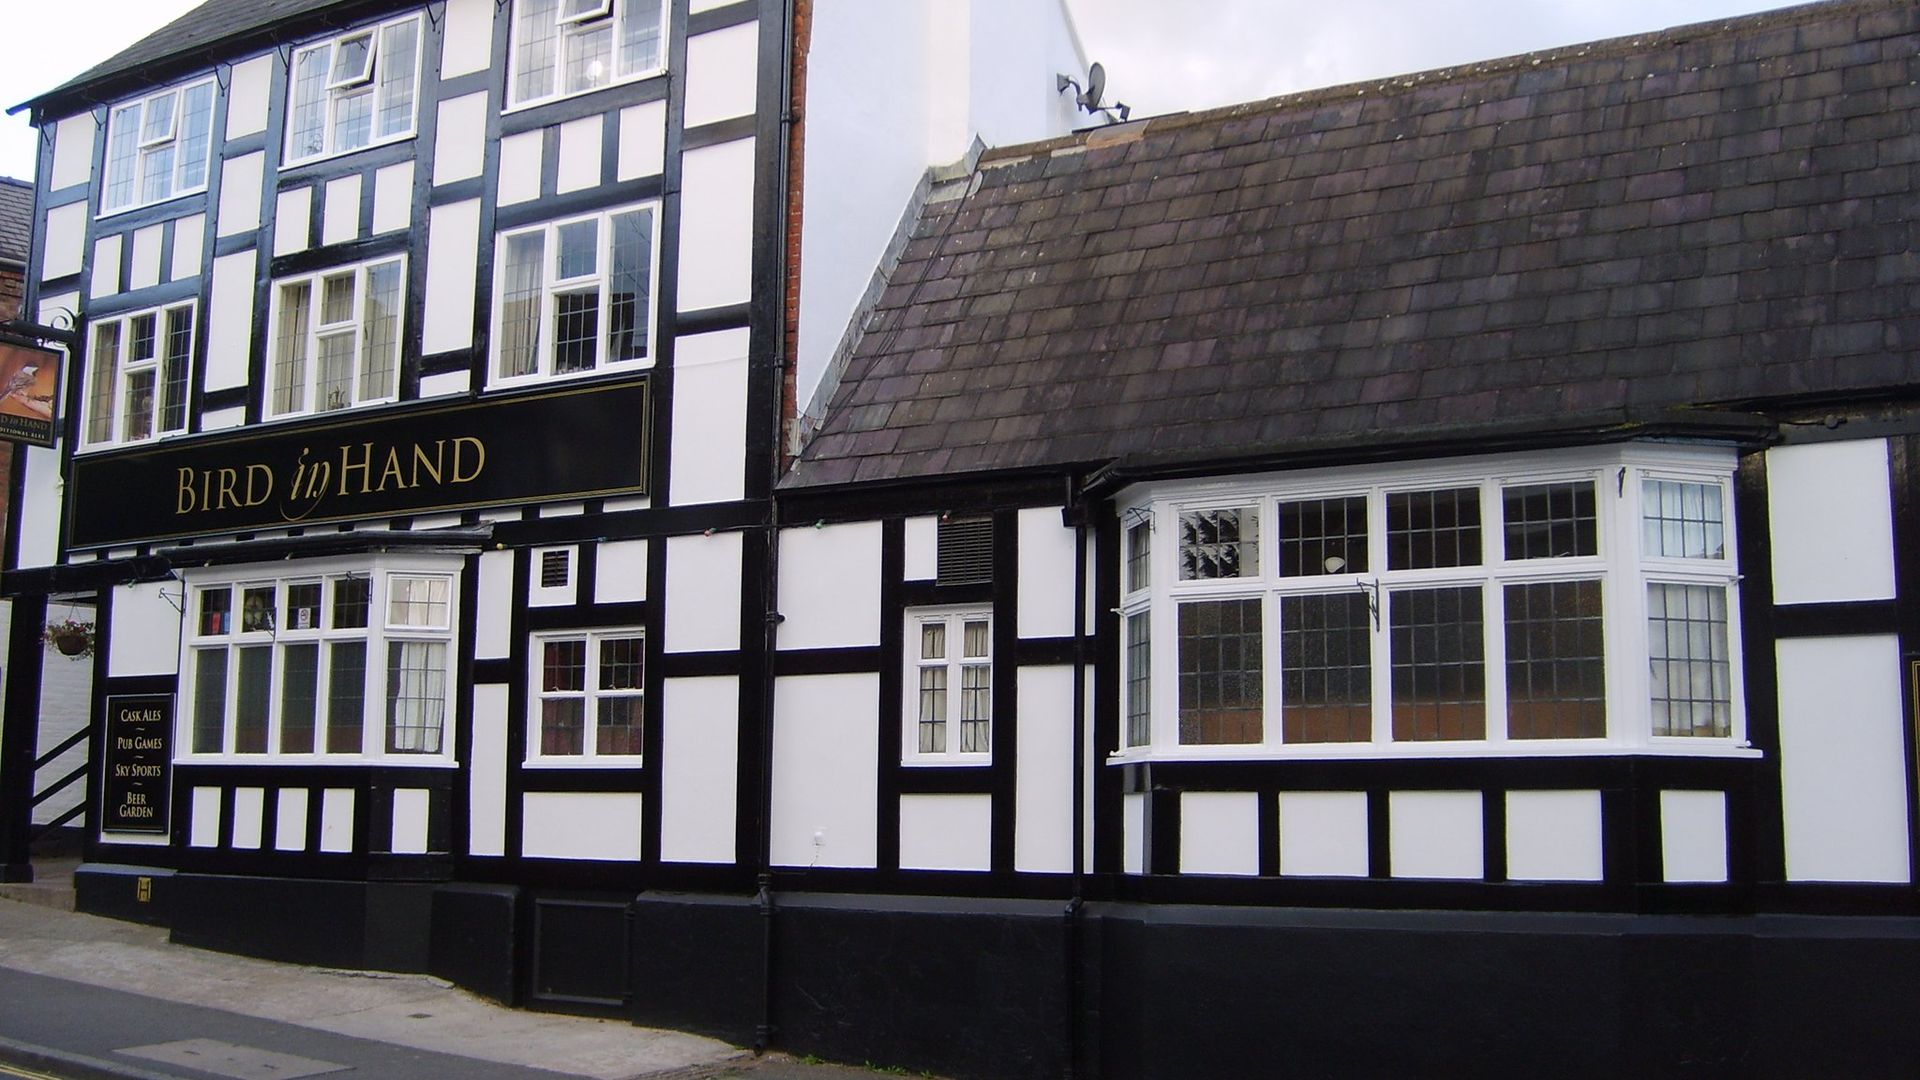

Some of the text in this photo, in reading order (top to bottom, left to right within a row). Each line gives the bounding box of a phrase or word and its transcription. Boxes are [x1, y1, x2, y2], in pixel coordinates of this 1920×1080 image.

[20, 417, 48, 430] HAND
[176, 436, 485, 521] BIRD in HAND
[120, 708, 161, 722] CASK ALES
[117, 737, 162, 749] PUB GAMES
[115, 763, 161, 777] SKY SPORTS
[127, 791, 146, 805] BEER
[119, 804, 153, 818] GARDEN
